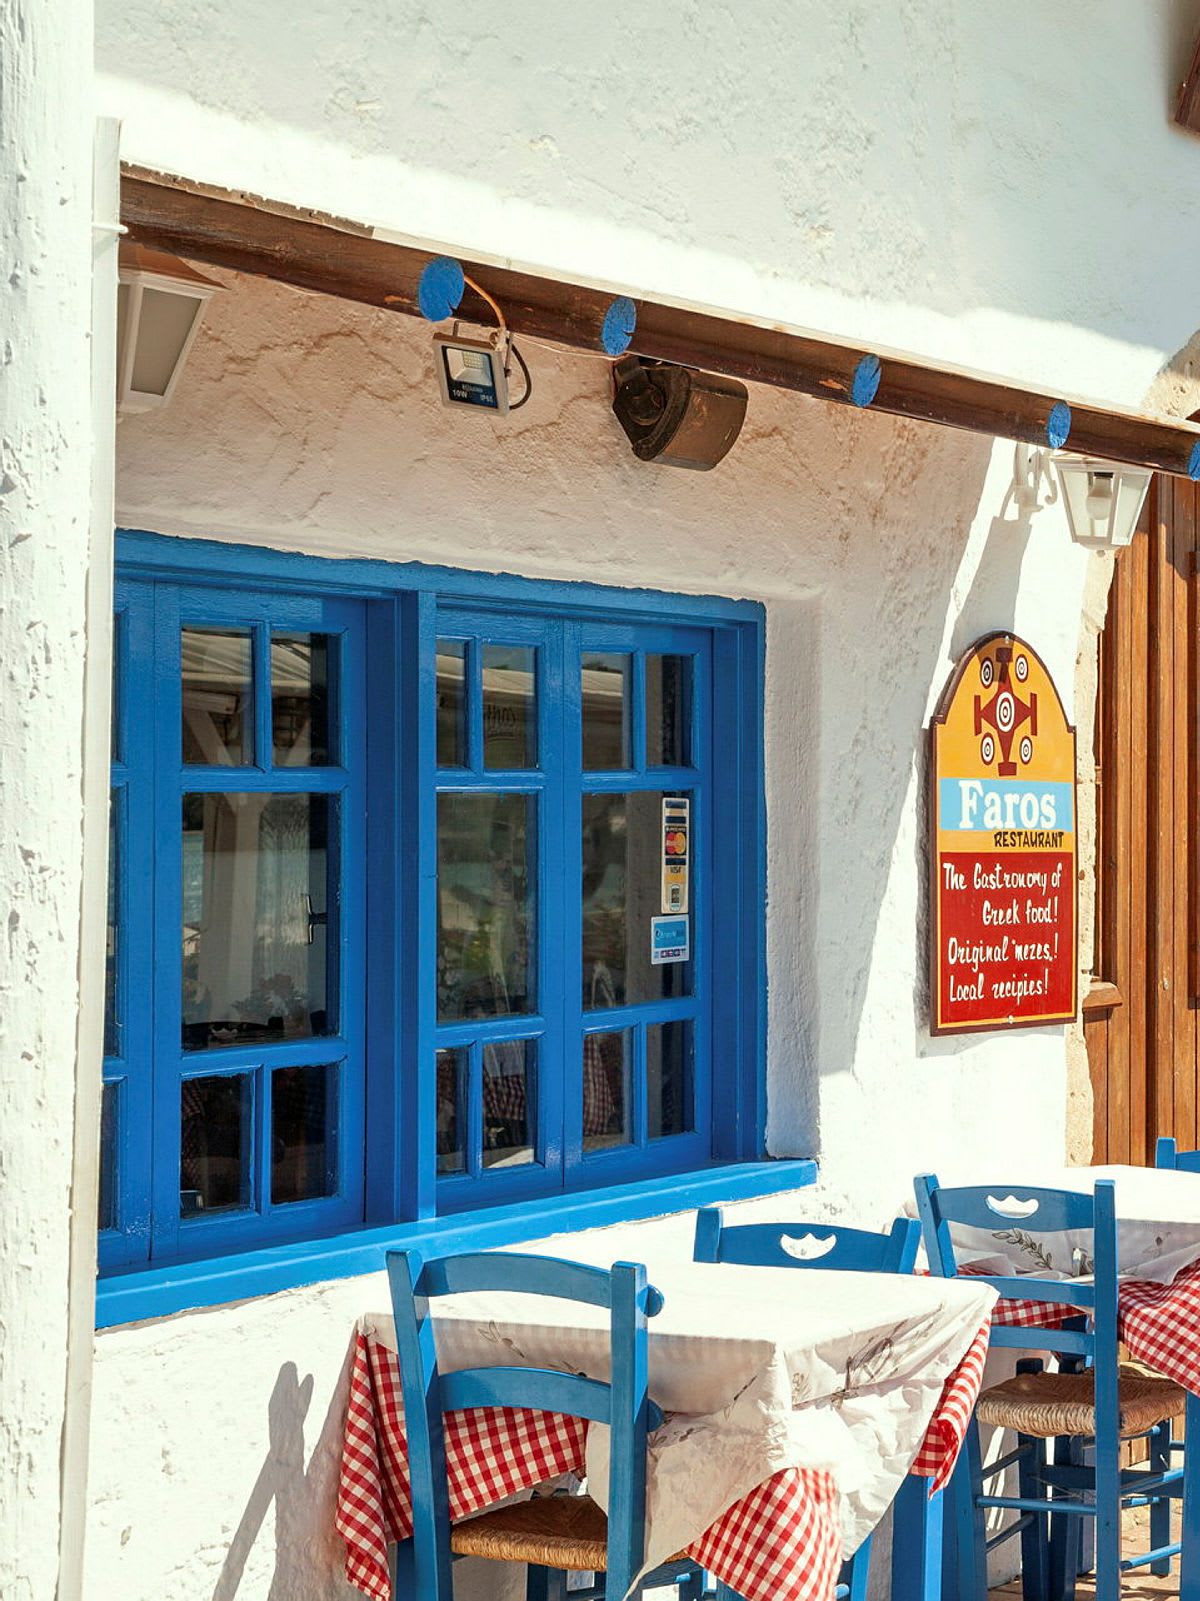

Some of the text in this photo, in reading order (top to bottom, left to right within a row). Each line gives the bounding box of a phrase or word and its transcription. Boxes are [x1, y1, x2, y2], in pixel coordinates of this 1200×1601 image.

[958, 780, 1057, 830] Faros
[993, 831, 1064, 848] RESTAURANT
[943, 862, 1063, 896] The Gastronomy of
[982, 896, 1058, 926] Greek food!
[948, 935, 1009, 973] Original
[949, 968, 1049, 1006] Local recipies!
